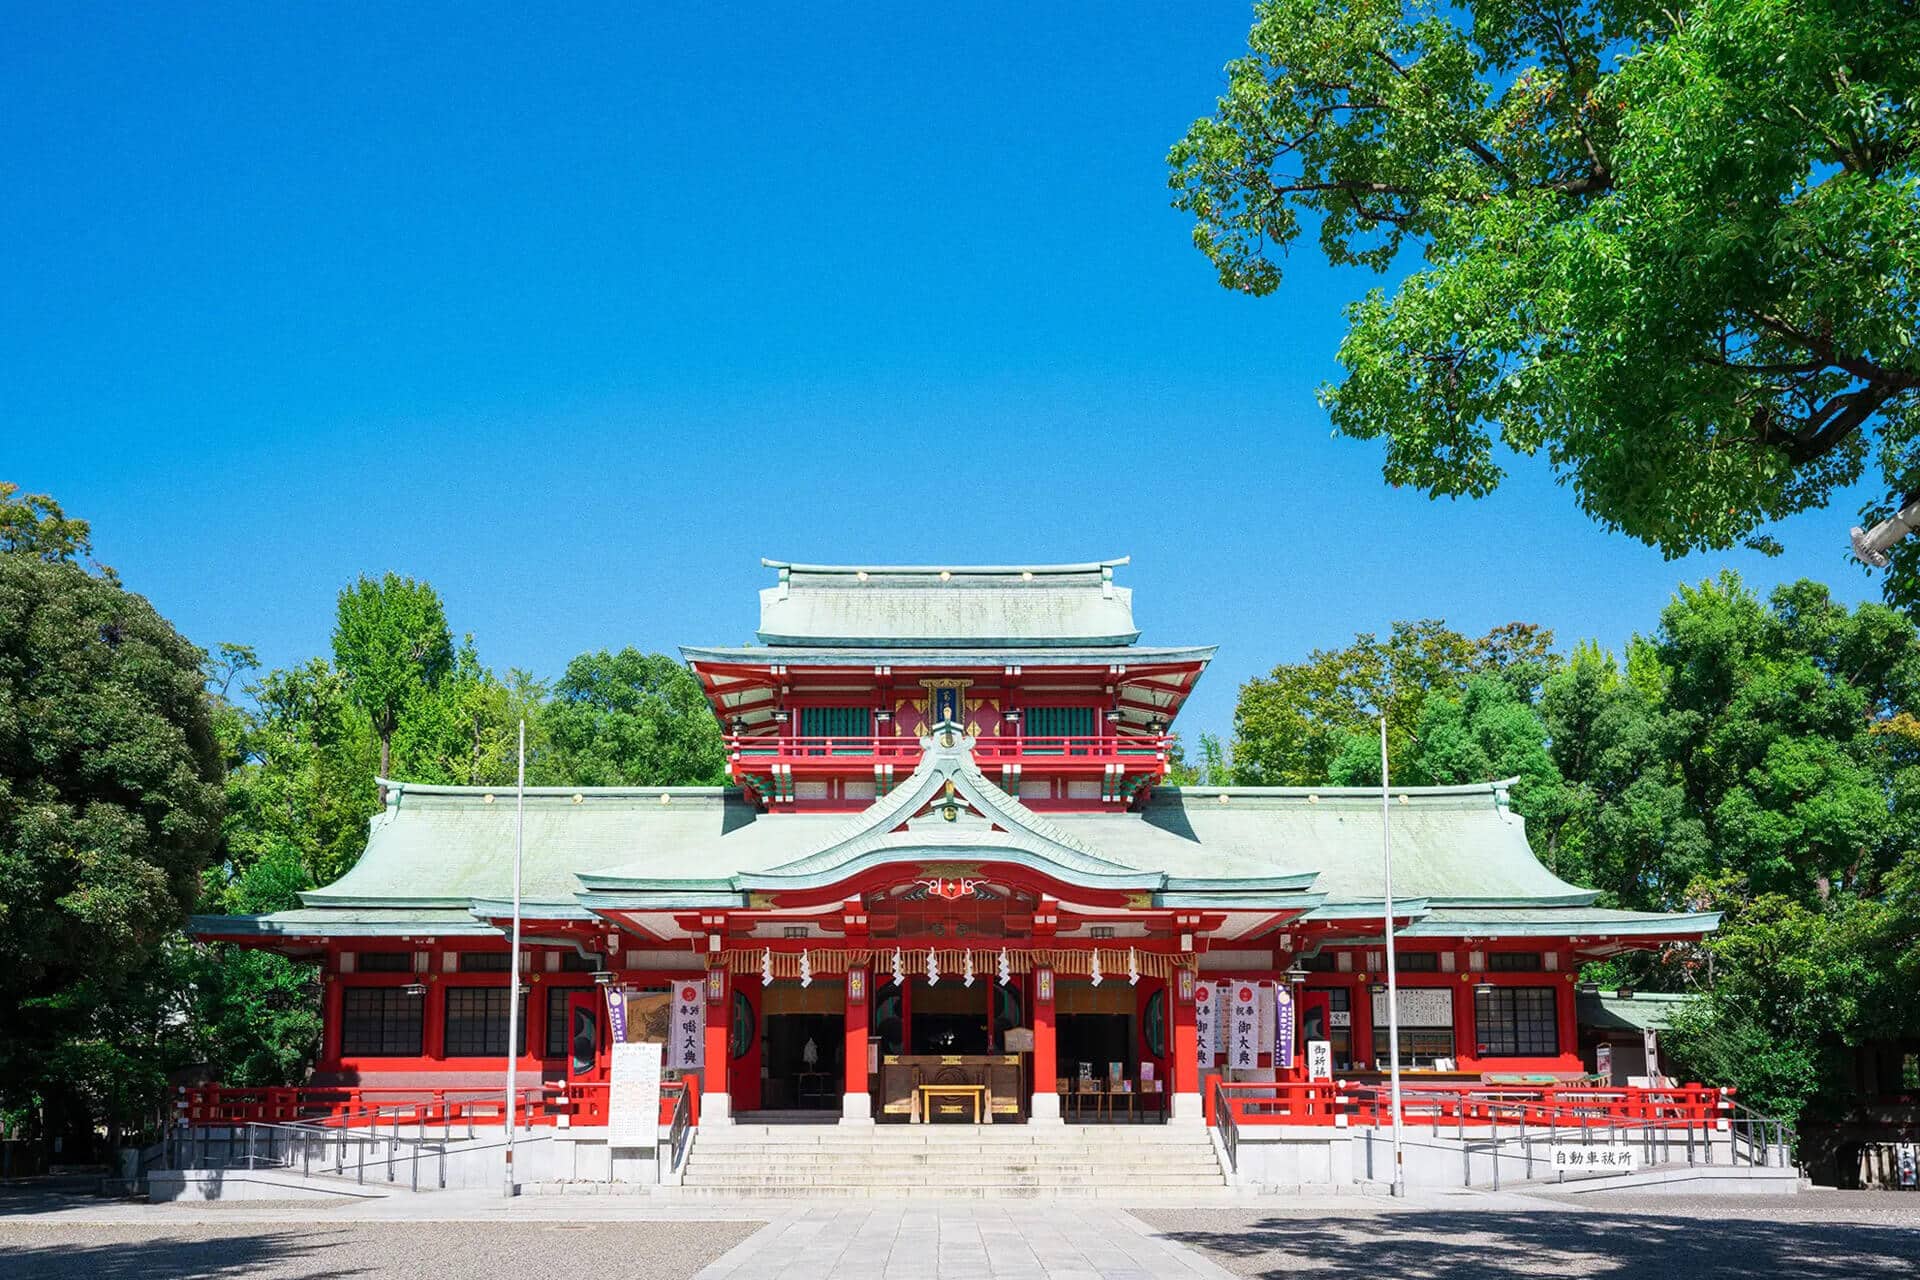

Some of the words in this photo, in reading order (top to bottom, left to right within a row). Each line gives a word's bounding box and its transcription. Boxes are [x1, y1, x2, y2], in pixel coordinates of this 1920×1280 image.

[1238, 1021, 1251, 1065] 御大典
[1556, 1150, 1632, 1166] 自動車祓所
